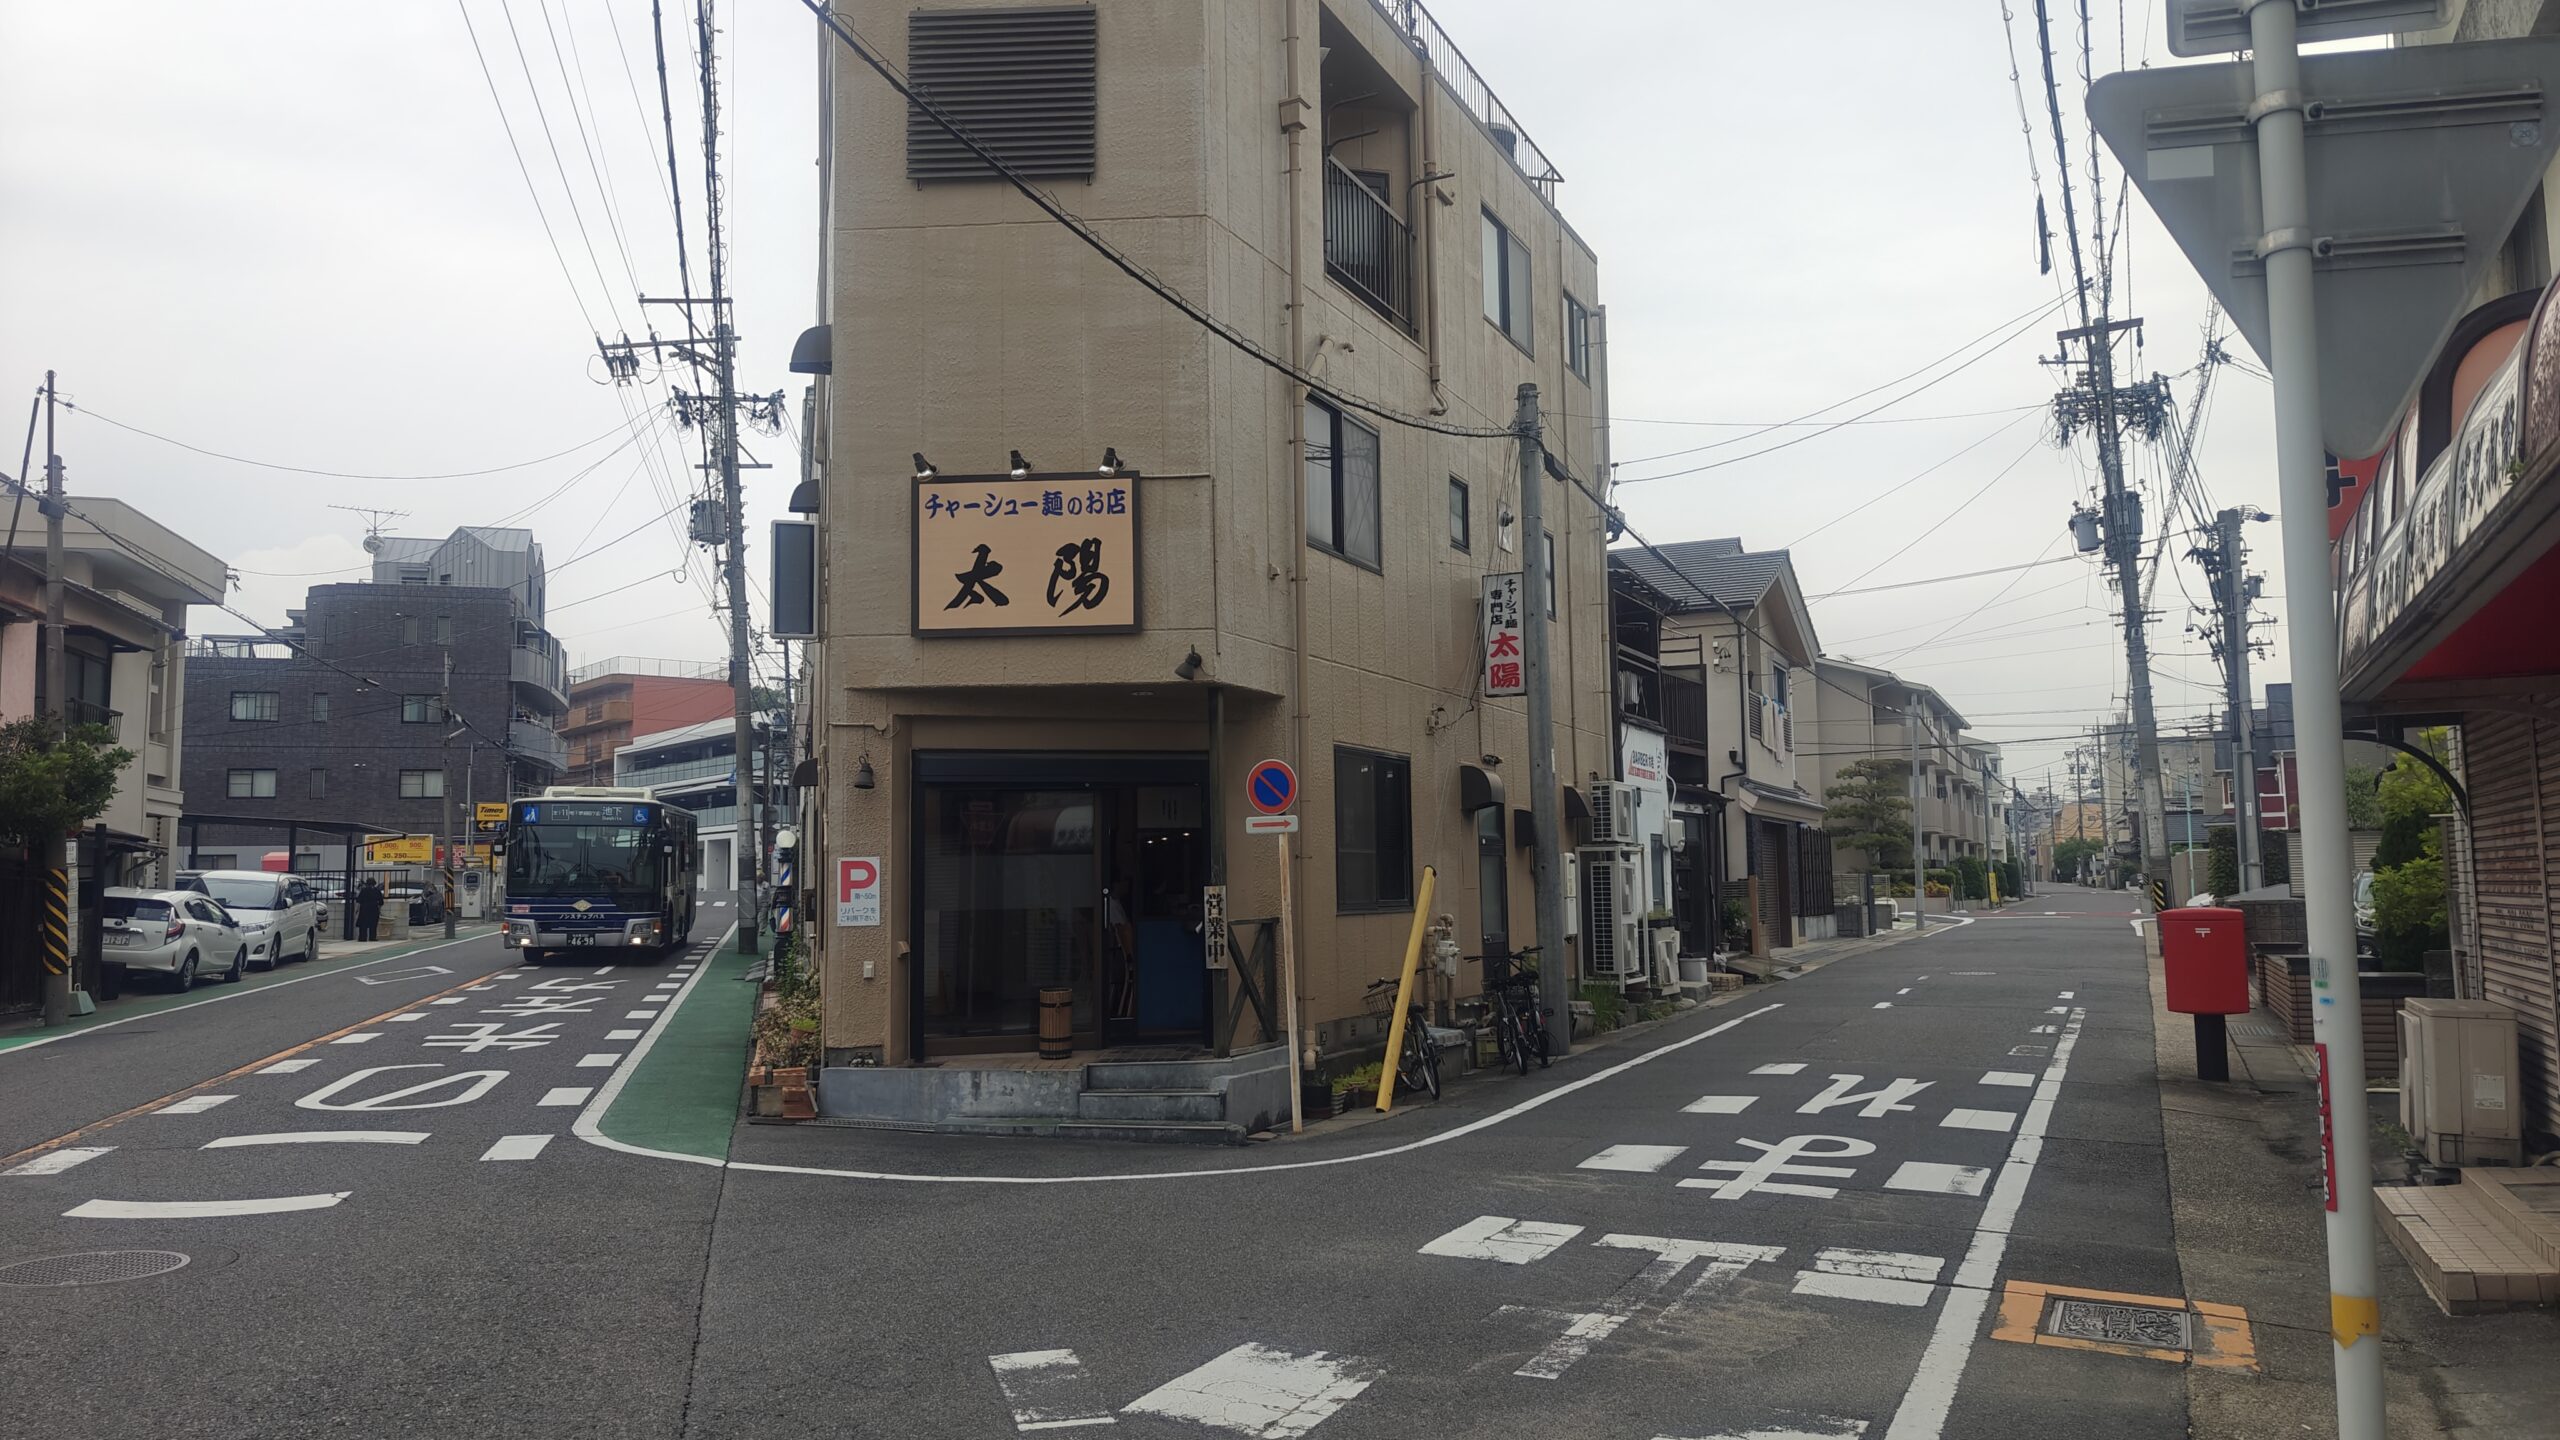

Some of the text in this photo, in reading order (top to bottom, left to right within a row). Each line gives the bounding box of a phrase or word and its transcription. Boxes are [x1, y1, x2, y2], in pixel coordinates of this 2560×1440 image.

[925, 488, 1127, 519] チャーシュー麺のお店
[944, 537, 1110, 617] 太陽
[1504, 579, 1518, 628] チャーシュー麺
[1489, 632, 1520, 689] 太陽
[480, 806, 504, 814] Times
[602, 806, 623, 816] 池下
[840, 860, 877, 903] P
[841, 907, 877, 915] リパークを
[1206, 892, 1226, 964] 営業中
[1484, 1073, 1938, 1379] 止まれ
